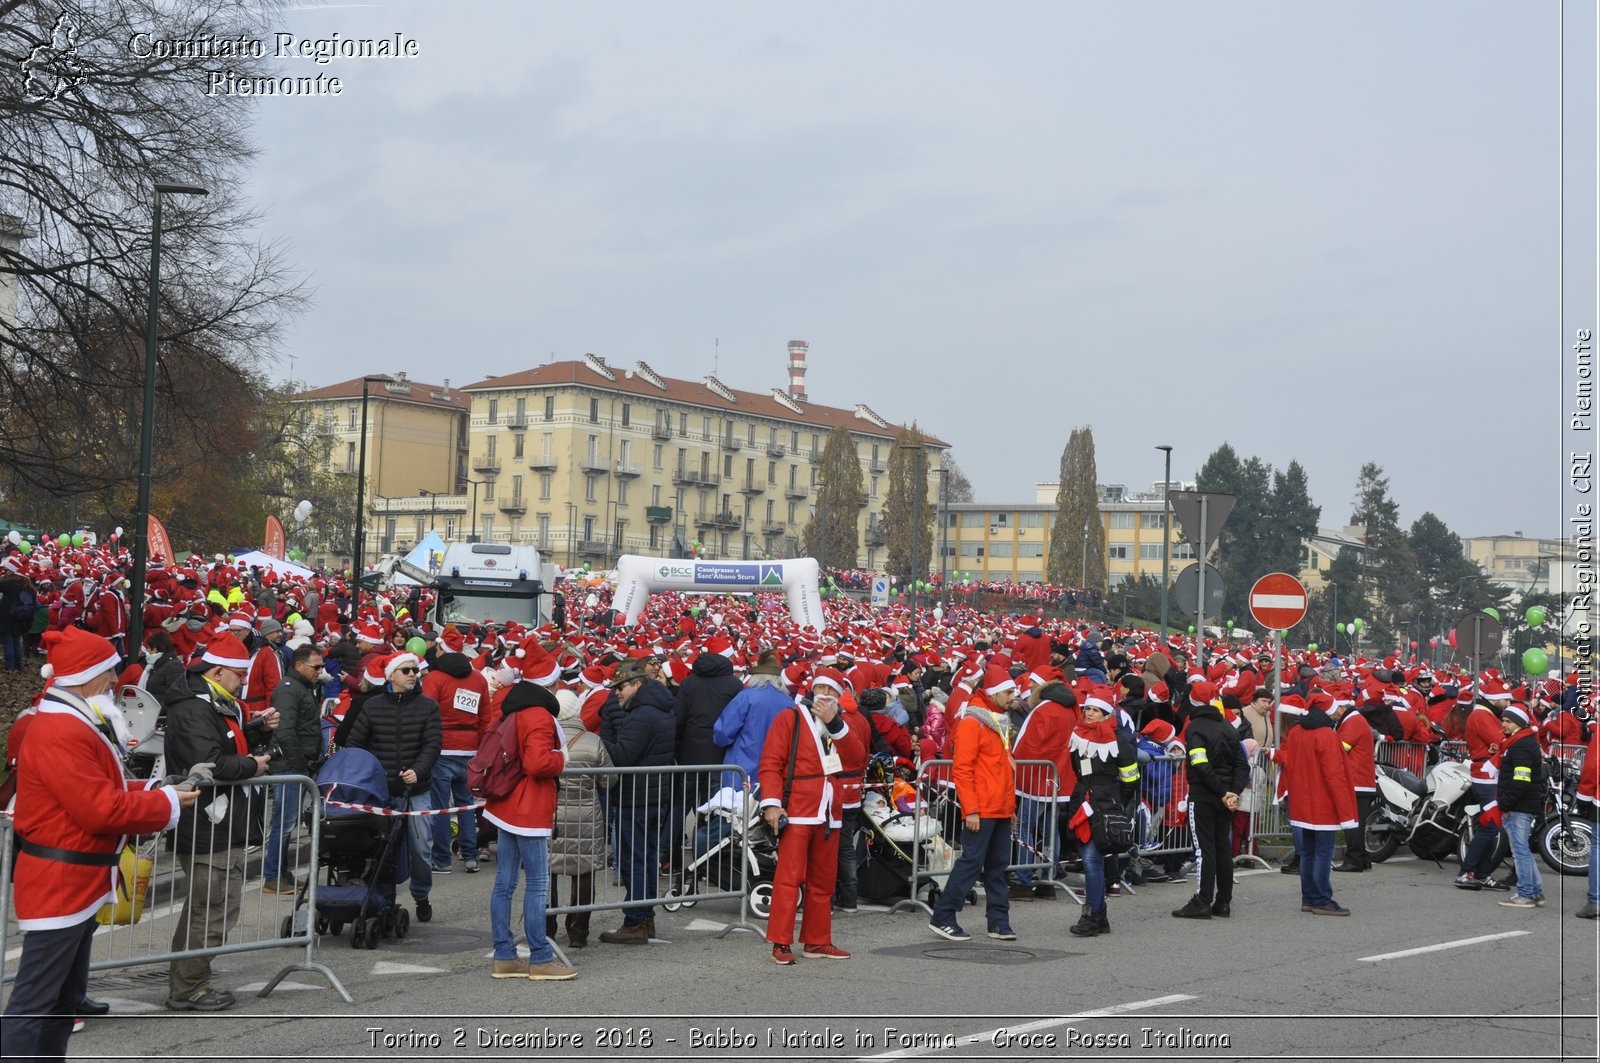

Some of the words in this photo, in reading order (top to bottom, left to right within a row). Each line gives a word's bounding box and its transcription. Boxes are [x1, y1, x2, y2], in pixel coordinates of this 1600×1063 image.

[670, 567, 692, 575] BCC
[697, 566, 734, 574] Casalgrasso
[697, 572, 736, 580] Sant'Albano
[456, 695, 477, 708] 1220
